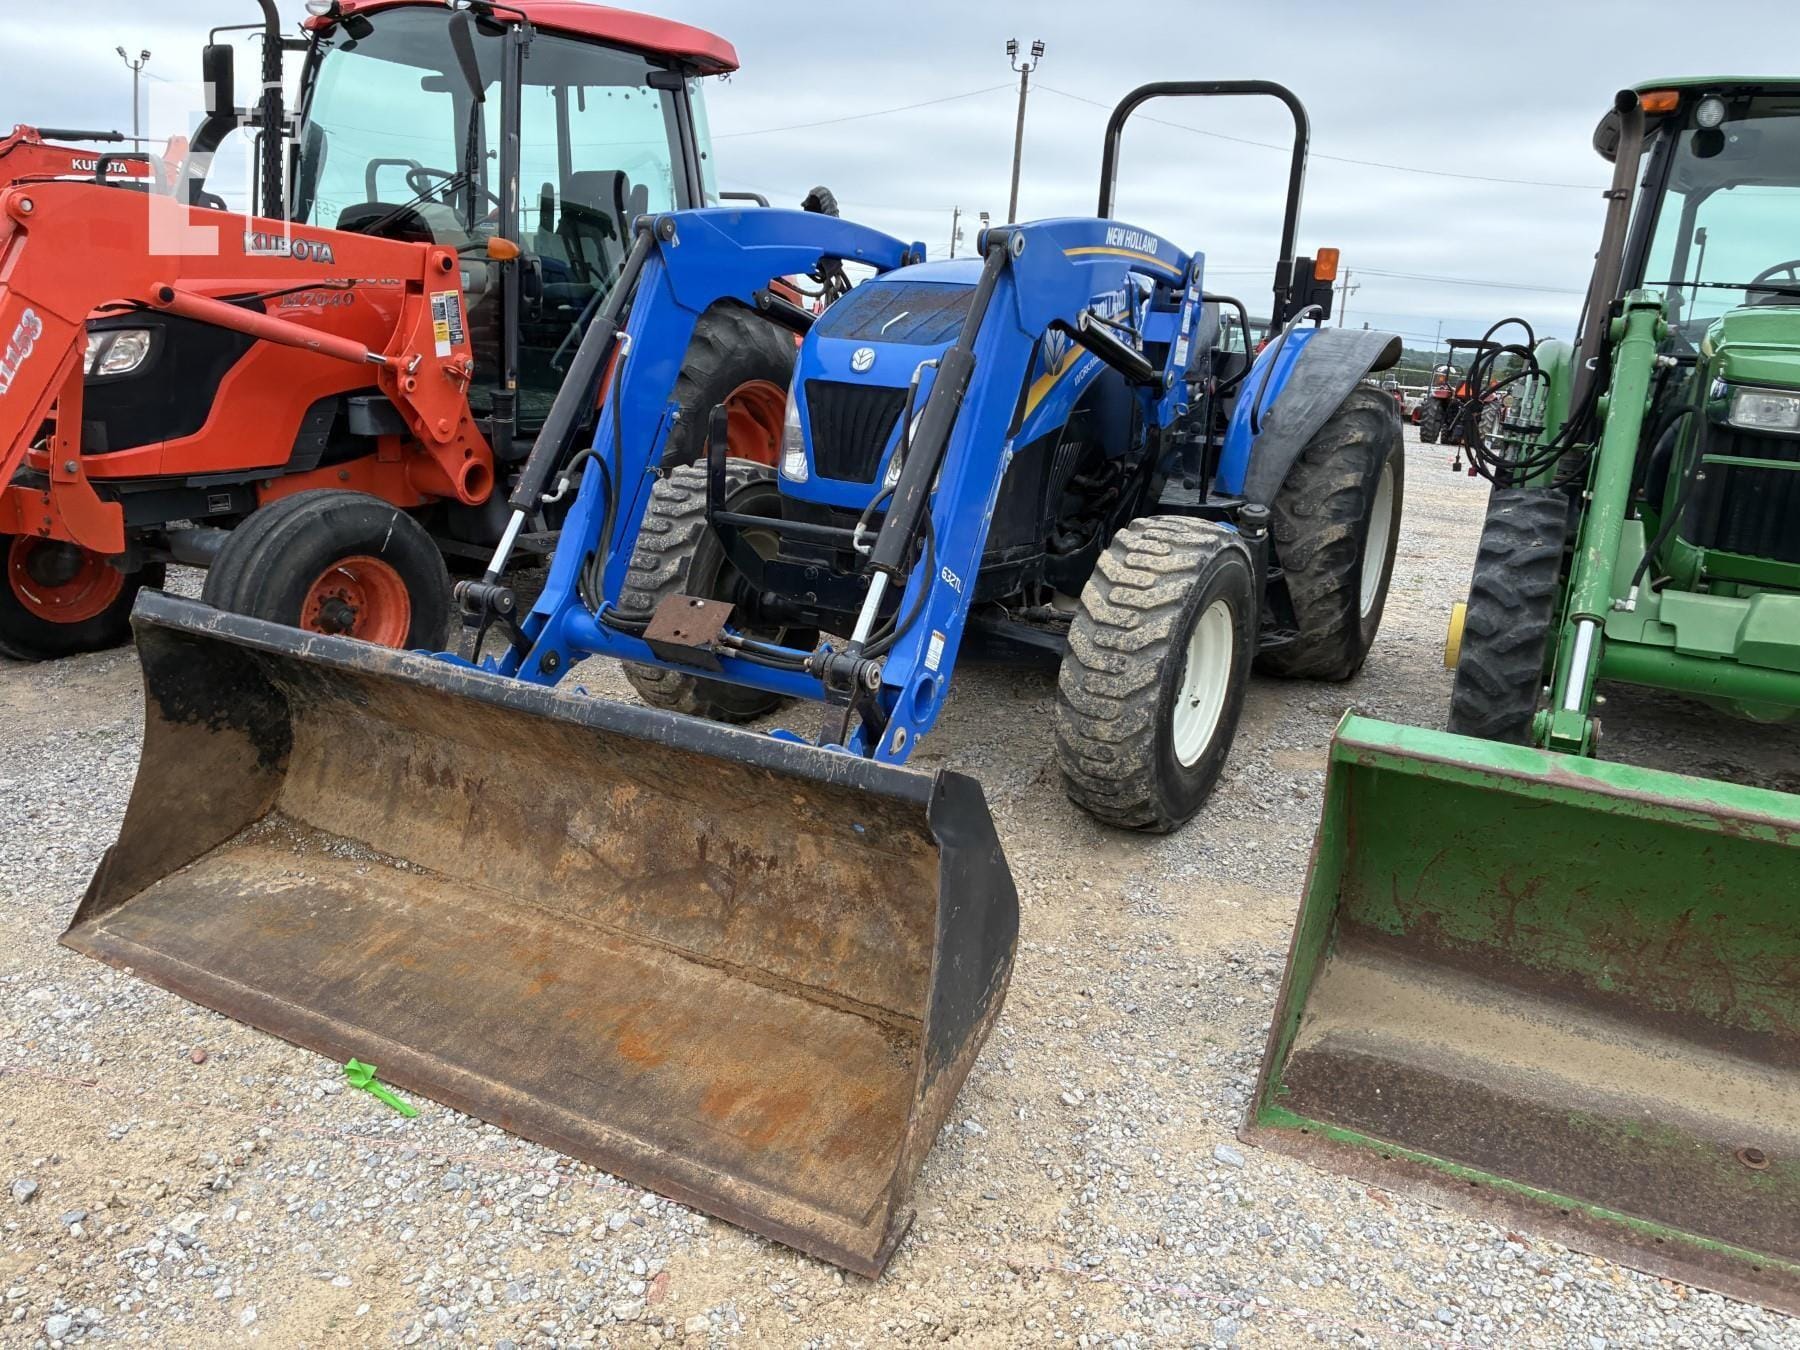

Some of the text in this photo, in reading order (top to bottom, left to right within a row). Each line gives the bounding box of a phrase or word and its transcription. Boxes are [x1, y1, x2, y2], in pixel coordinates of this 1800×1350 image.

[242, 231, 335, 265] KUBOTA
[1105, 226, 1158, 255] NEW HOLLAND
[941, 565, 962, 594] 632TL
